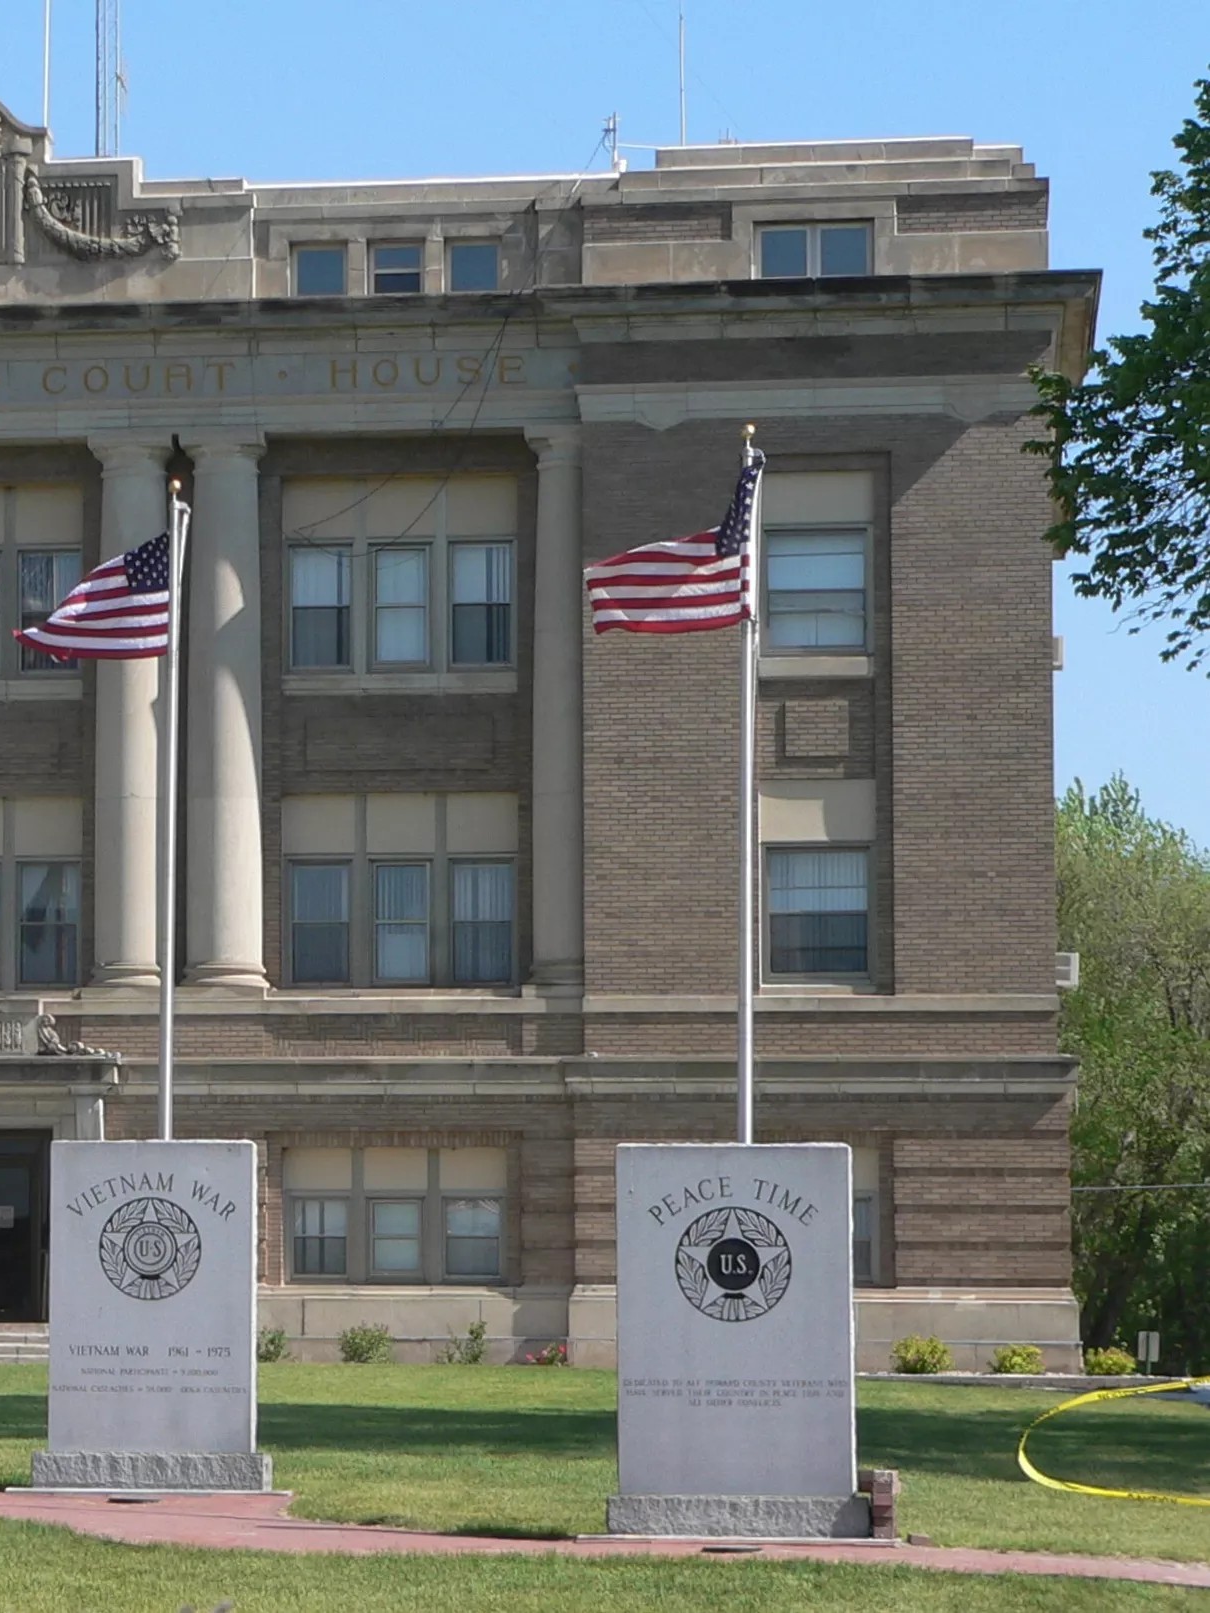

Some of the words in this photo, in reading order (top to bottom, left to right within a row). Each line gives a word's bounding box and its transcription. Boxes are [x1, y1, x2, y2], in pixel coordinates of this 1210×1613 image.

[41, 361, 236, 395] COURT
[330, 355, 528, 389] HOUSE
[66, 1171, 175, 1217] VIETNAM
[190, 1180, 236, 1221] WAR
[647, 1176, 734, 1226] PEACE
[753, 1178, 819, 1227] TIME
[68, 1344, 120, 1357] VIETNAM
[125, 1345, 149, 1358] WAR
[167, 1346, 189, 1358] 1961
[206, 1346, 231, 1358] 1975
